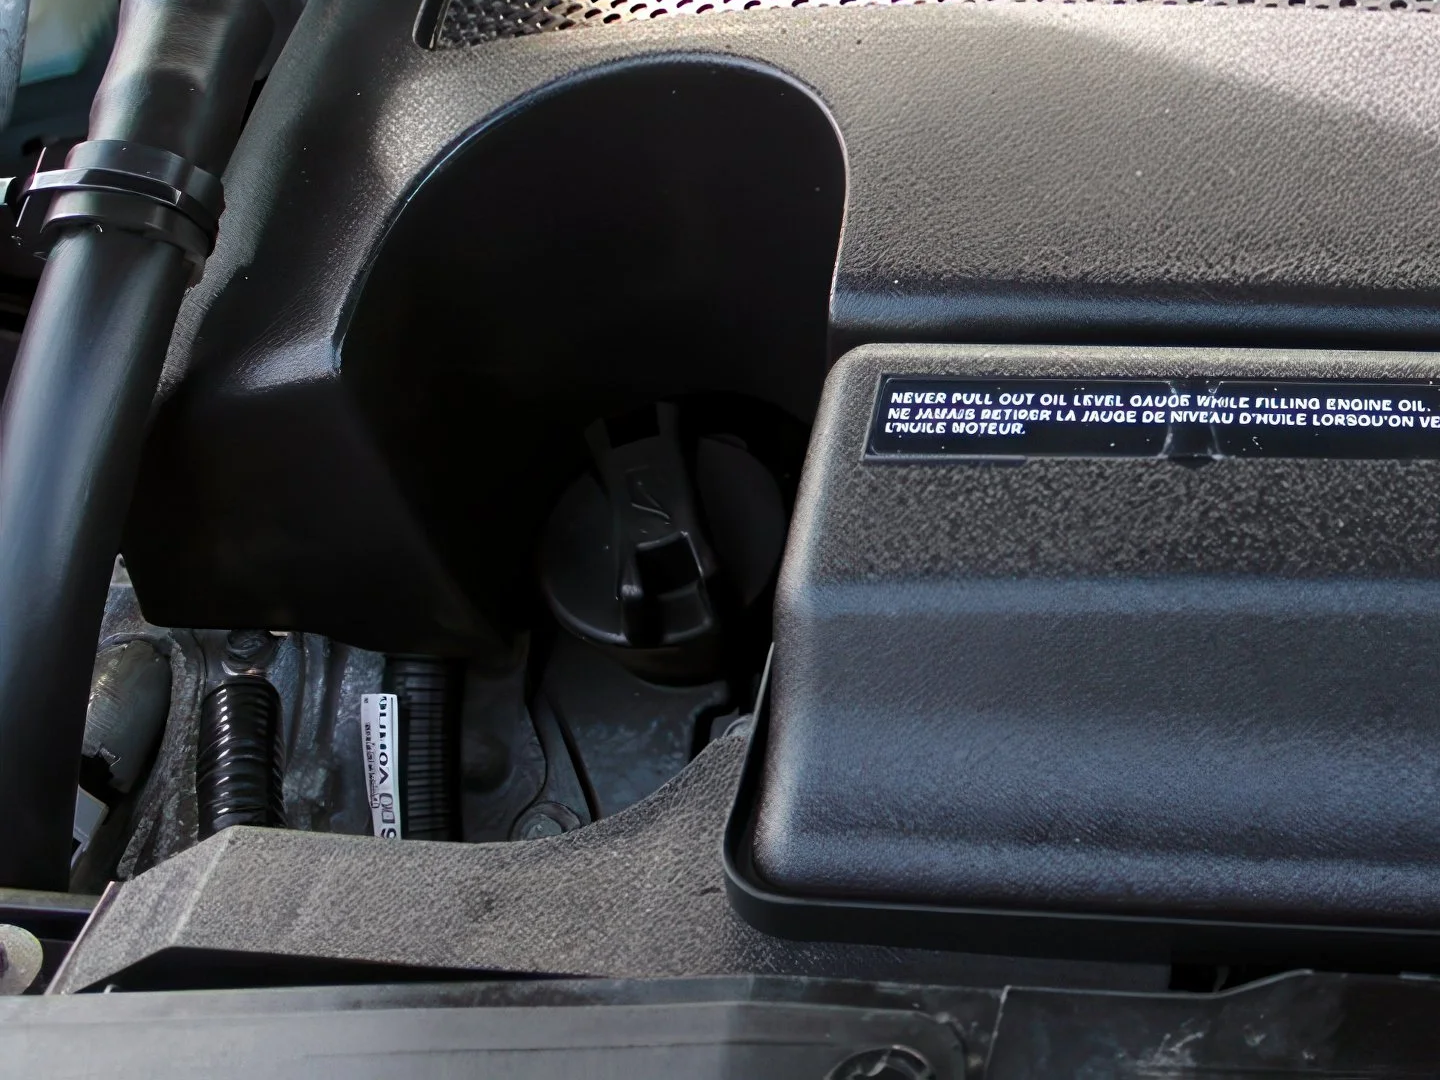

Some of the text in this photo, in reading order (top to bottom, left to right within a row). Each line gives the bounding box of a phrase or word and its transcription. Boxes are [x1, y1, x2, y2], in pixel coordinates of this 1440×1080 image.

[891, 392, 1431, 412] NEVER PULL OUT OIL LEVEL GAUGE WHILE FILLING ENGINE OIL.
[888, 408, 910, 420] NE
[915, 408, 975, 420] JAMAIS
[981, 409, 1051, 421] RETIRER
[1056, 410, 1076, 421] LA
[1081, 411, 1137, 423] JAUGE
[1142, 411, 1165, 423] DE
[1170, 411, 1233, 424] NIVEAU
[1239, 413, 1307, 426] D'HUILE
[1313, 414, 1414, 427] LORSQU'ON
[885, 422, 1025, 435] L'HUILE MOTEUR.
